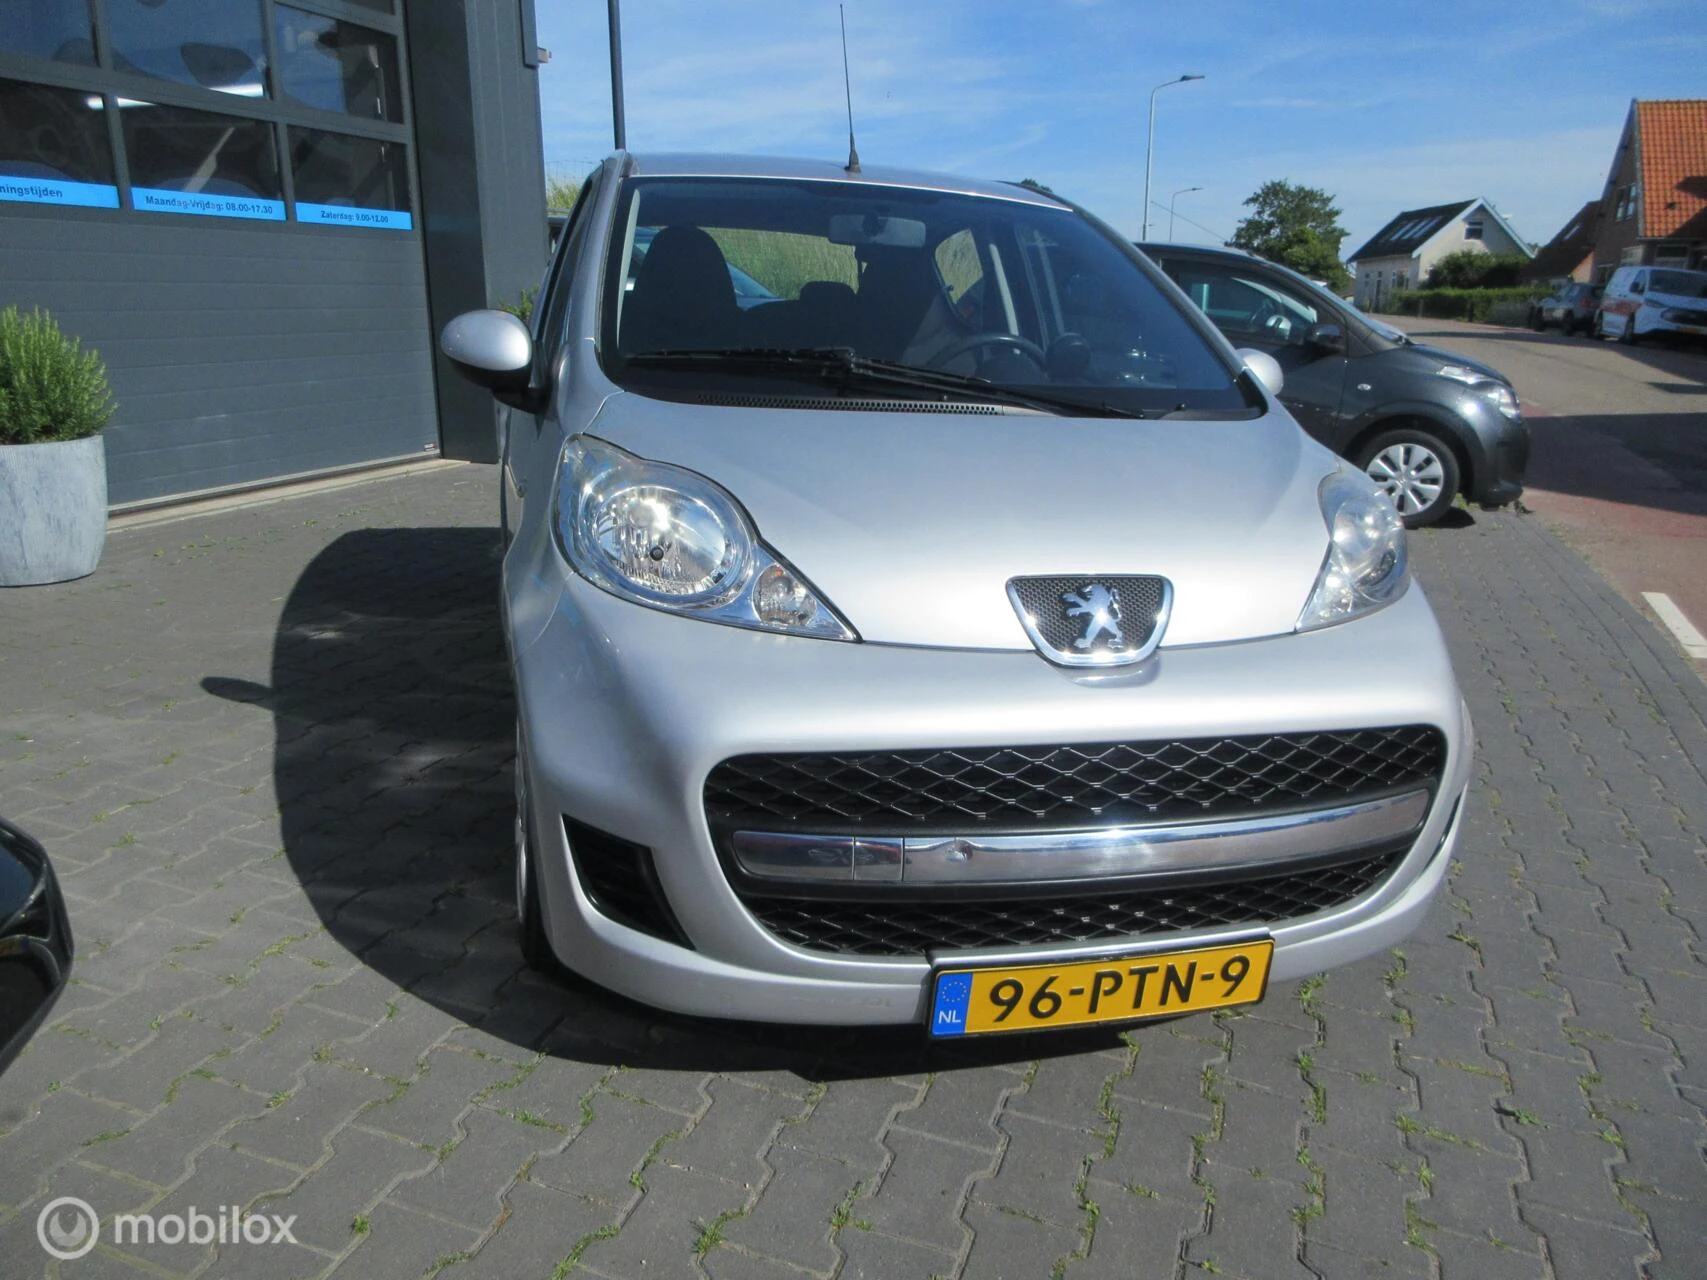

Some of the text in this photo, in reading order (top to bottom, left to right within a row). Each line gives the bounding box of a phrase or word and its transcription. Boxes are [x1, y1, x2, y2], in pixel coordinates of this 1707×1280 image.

[145, 195, 273, 214] Maandag-Vrijdag: 08.00-17.30
[320, 210, 389, 223] Zaterdag: 9.00-12.00
[988, 955, 1250, 1022] 96-PTN-9
[938, 1010, 961, 1024] NL
